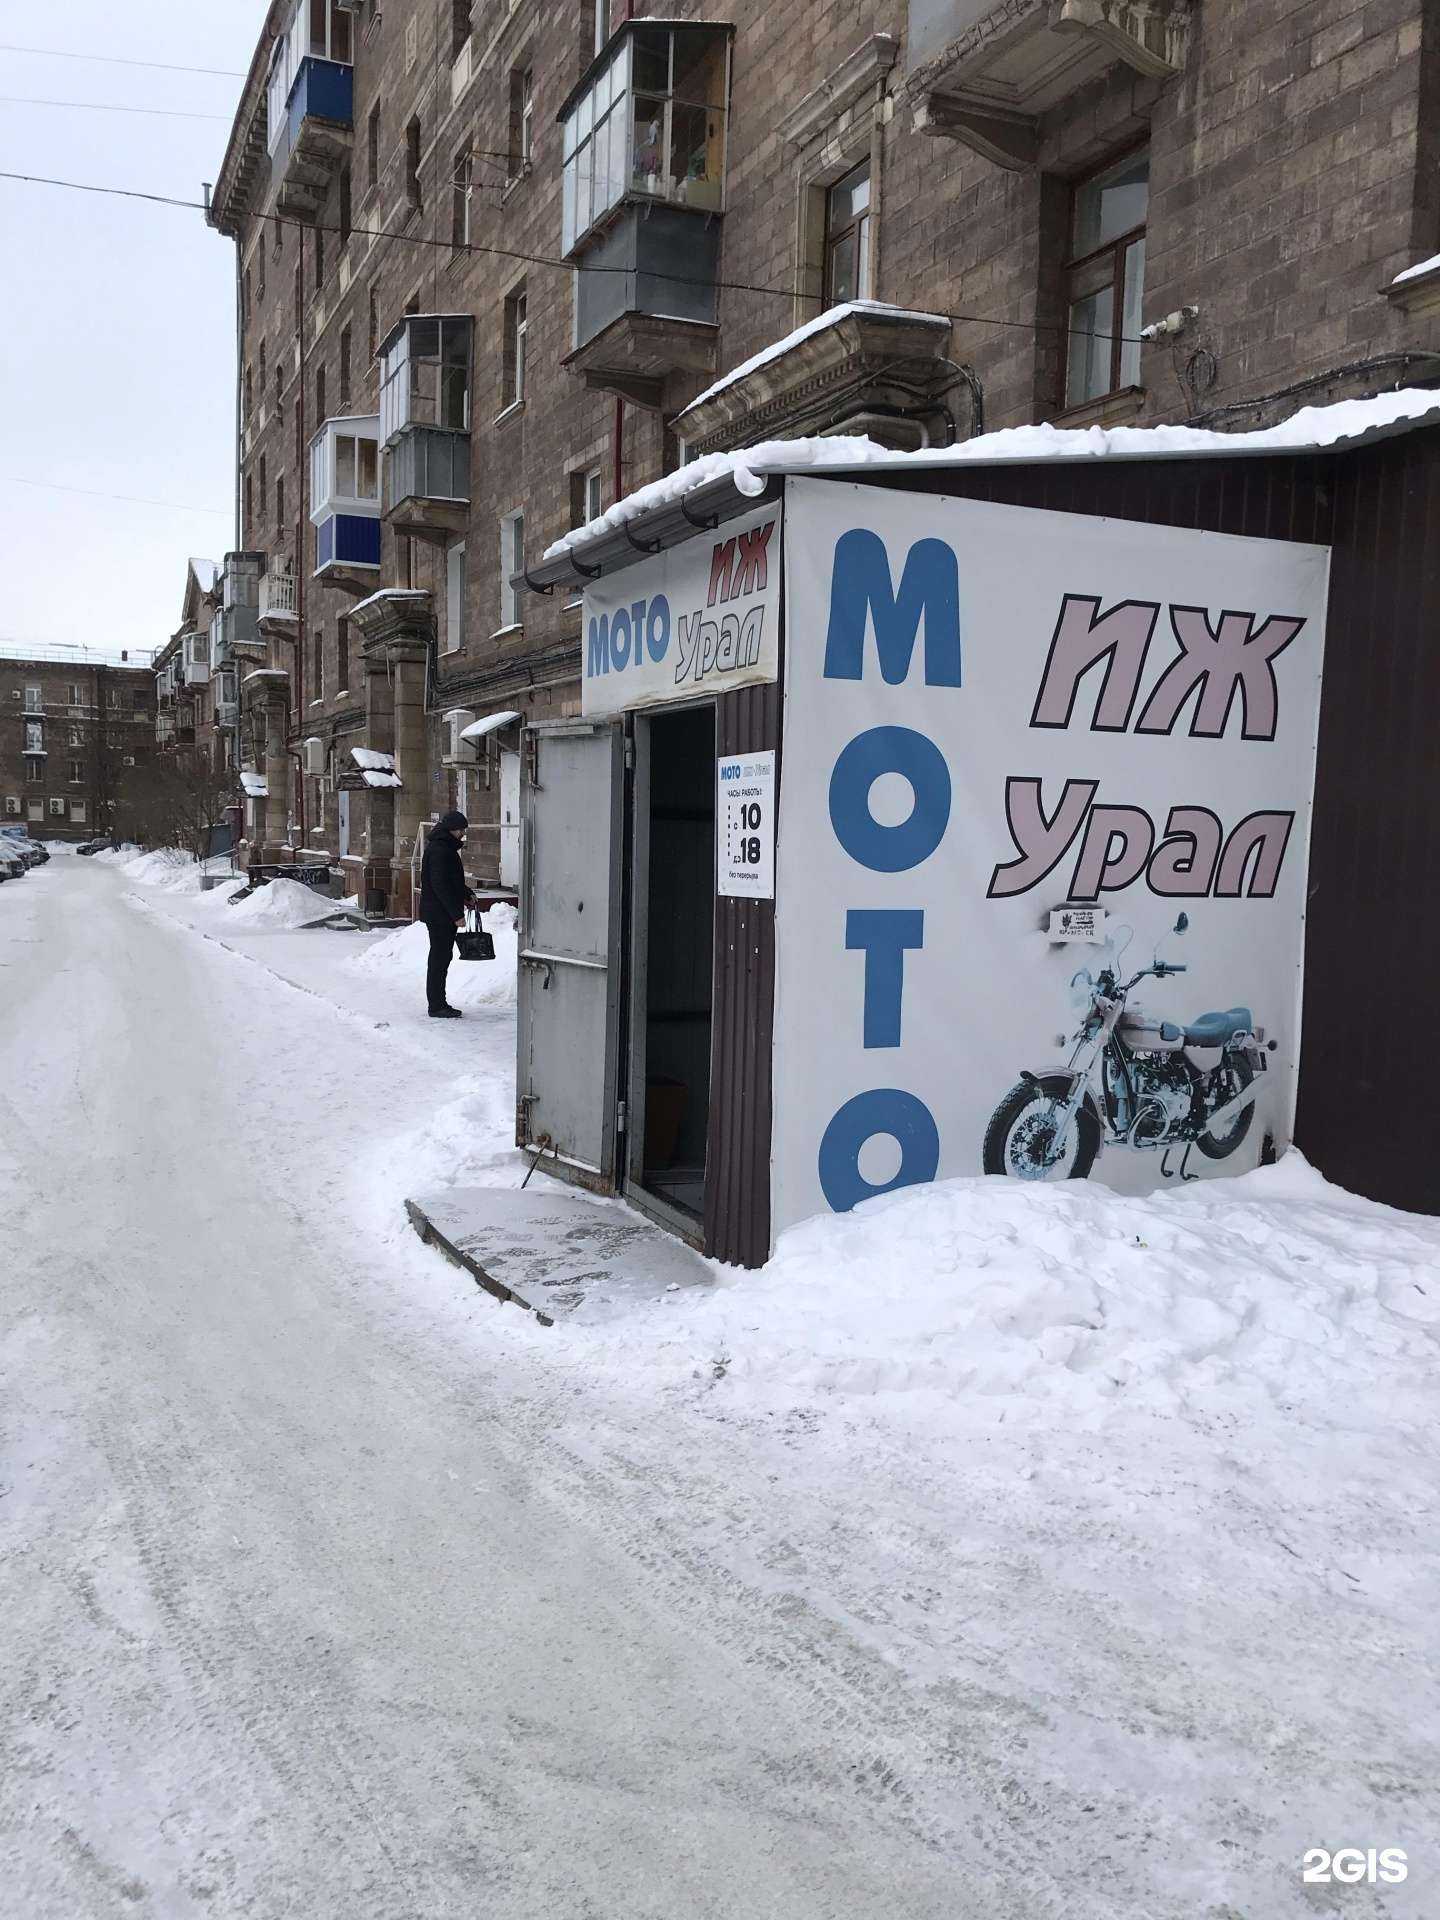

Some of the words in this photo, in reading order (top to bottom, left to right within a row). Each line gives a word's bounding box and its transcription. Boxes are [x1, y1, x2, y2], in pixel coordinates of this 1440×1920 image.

[707, 520, 775, 609] ИЖ
[587, 594, 671, 678] МОТО
[675, 604, 765, 684] Урал
[1029, 593, 1307, 742] ИЖ
[720, 764, 741, 780] МОТО
[741, 803, 761, 830] 10
[741, 837, 760, 864] 18
[986, 776, 1296, 902] Урал
[818, 528, 962, 1213] МОТО
